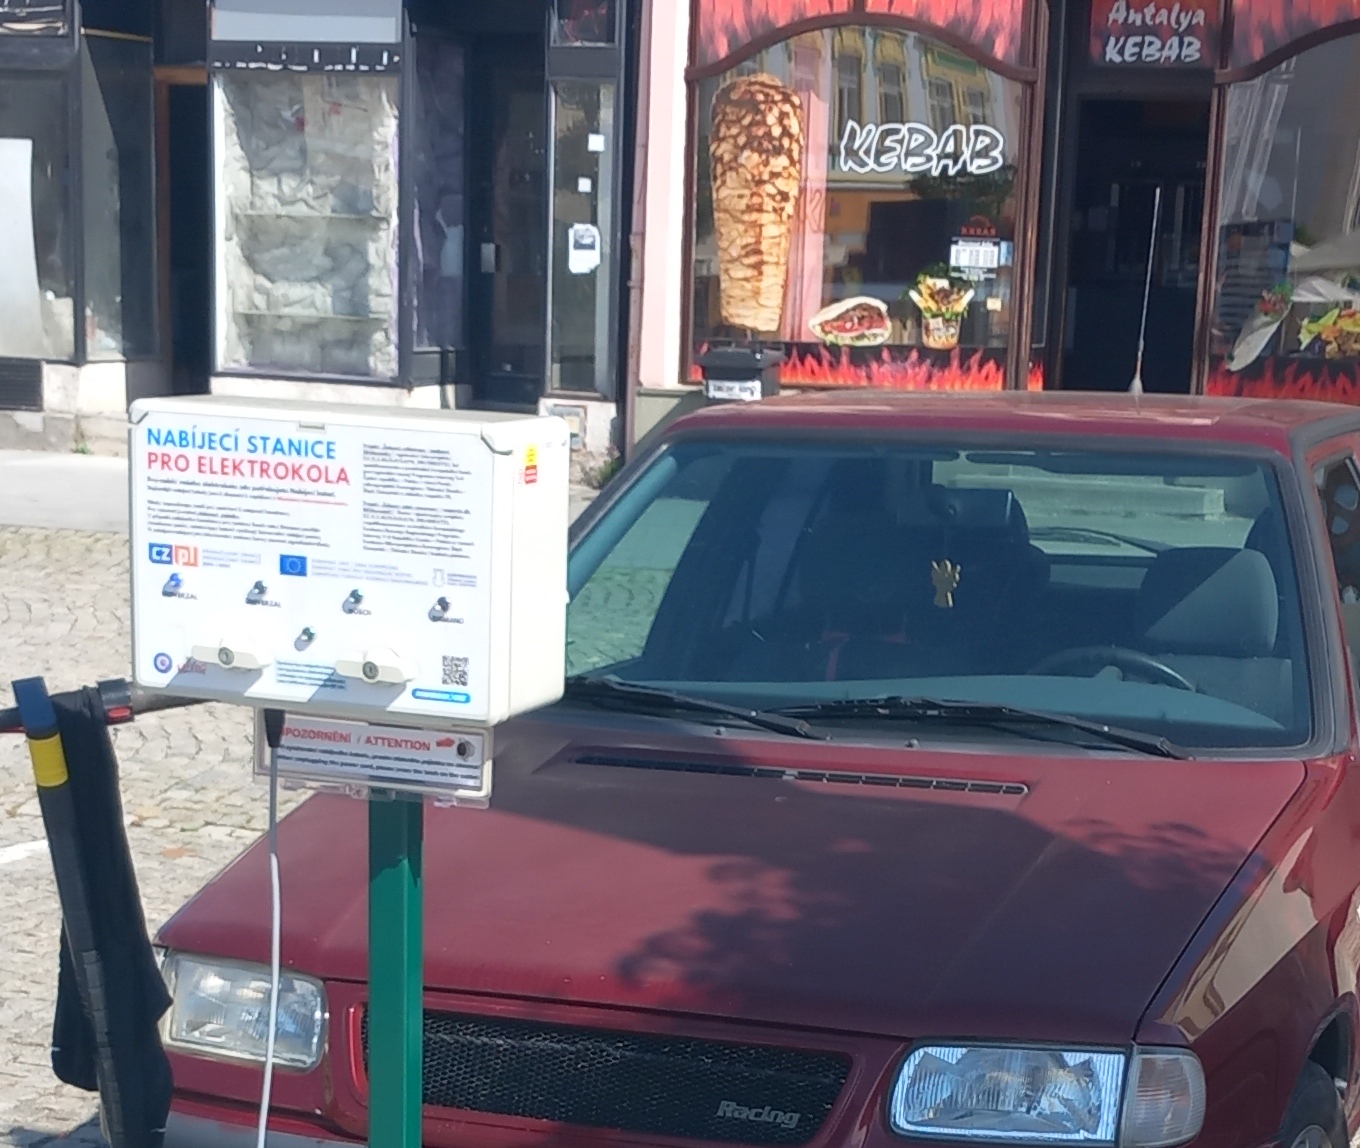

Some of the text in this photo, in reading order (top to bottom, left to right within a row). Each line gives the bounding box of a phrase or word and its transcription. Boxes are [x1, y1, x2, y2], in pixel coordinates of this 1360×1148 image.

[1107, 0, 1206, 32] Antalya
[1105, 34, 1202, 63] KEBAB
[840, 120, 1005, 177] KEBAB
[146, 425, 337, 460] NABÍJECÍ STANICE
[147, 451, 190, 472] PRO
[197, 455, 351, 486] ELEKTROKOLA
[365, 735, 431, 751] ATTENTION
[715, 1100, 801, 1129] Racing
